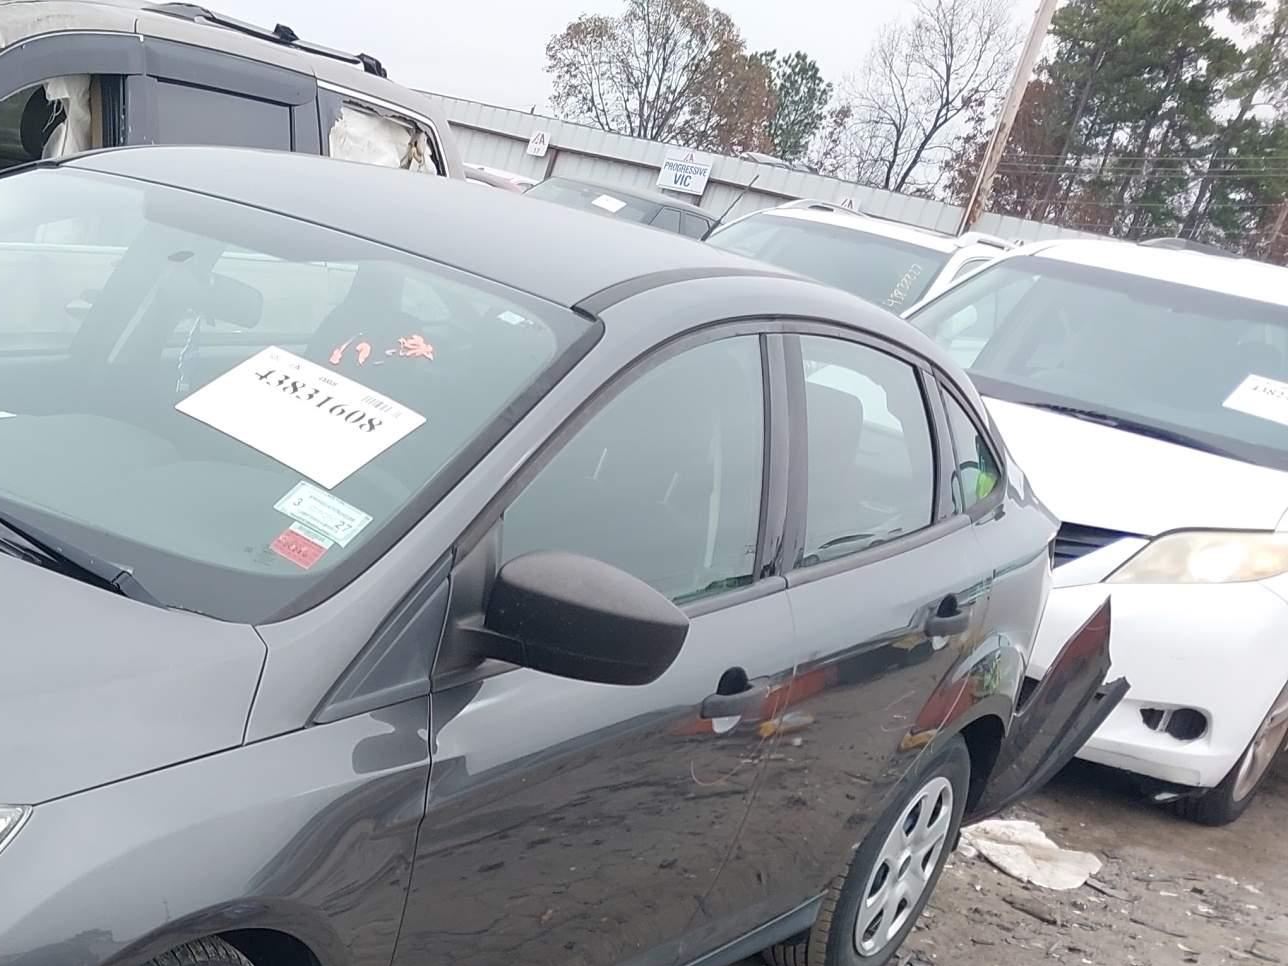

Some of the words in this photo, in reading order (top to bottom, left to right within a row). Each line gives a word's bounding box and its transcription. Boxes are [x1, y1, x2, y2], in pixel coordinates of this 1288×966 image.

[663, 161, 708, 177] PROGRESSIVE
[673, 173, 692, 187] VIC
[255, 369, 383, 433] 43831608
[334, 521, 353, 532] 27
